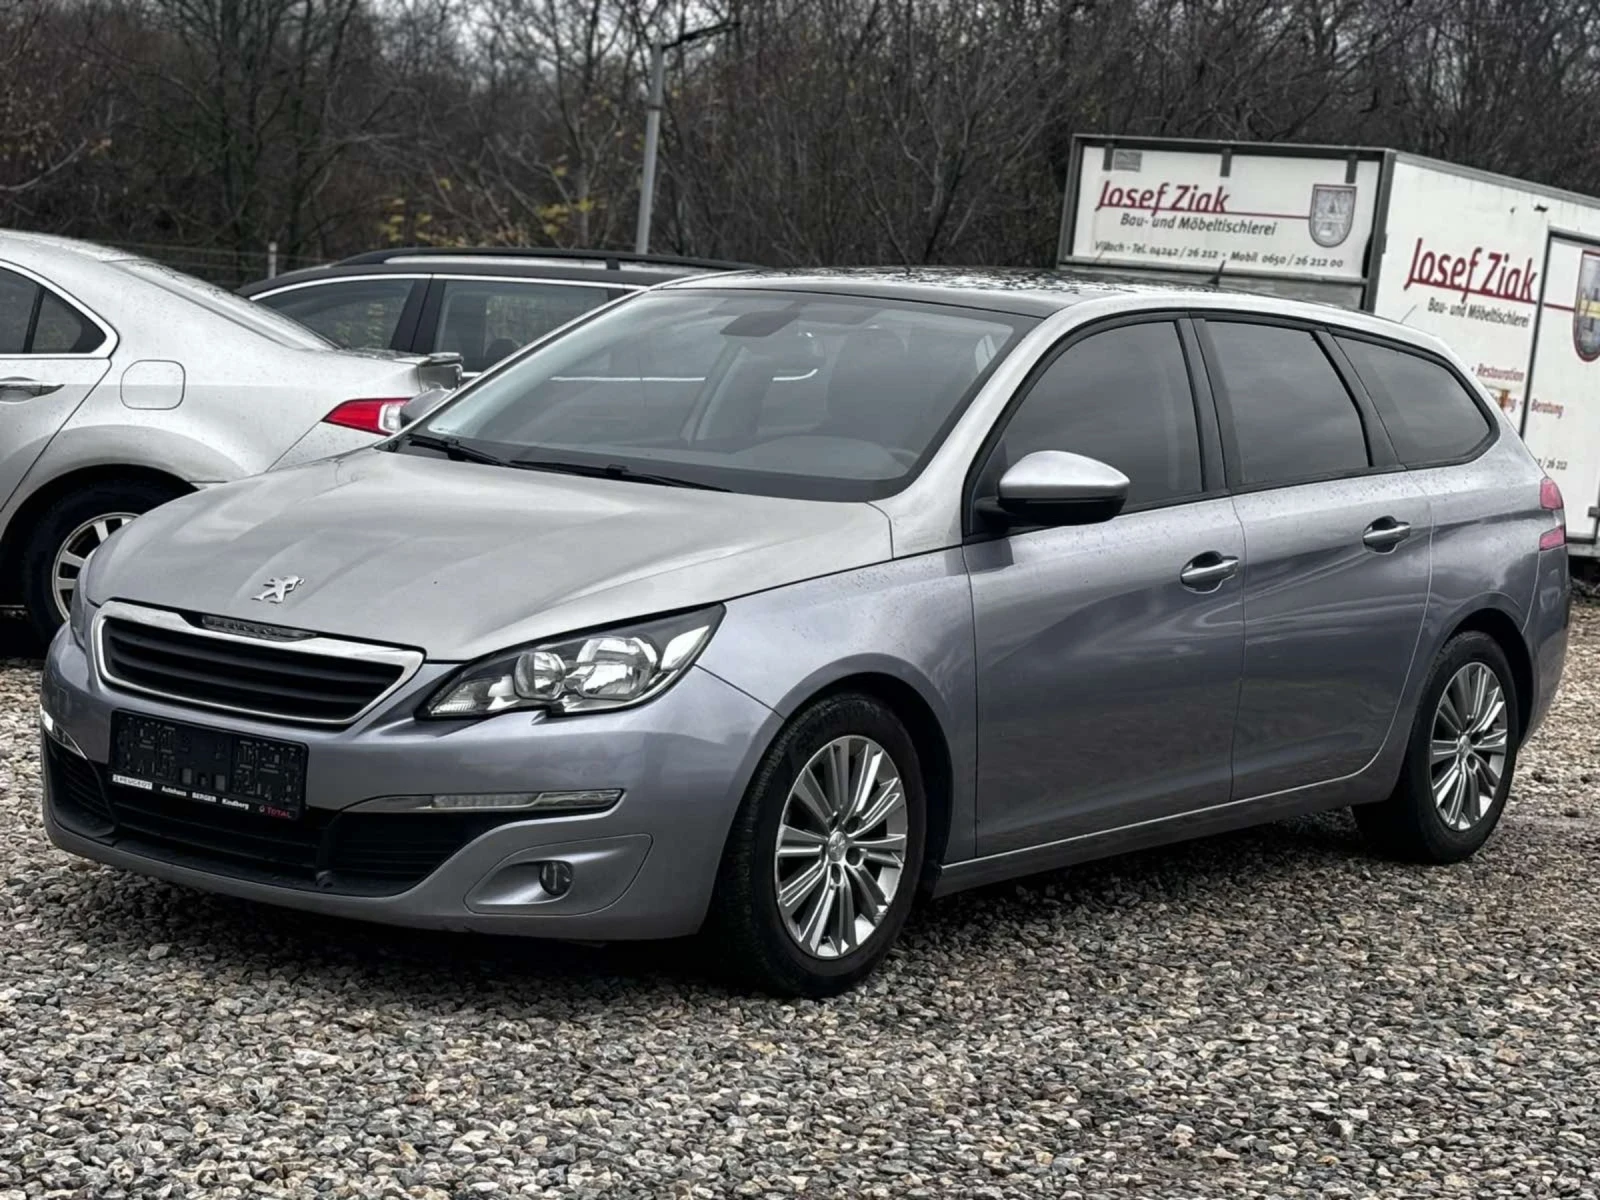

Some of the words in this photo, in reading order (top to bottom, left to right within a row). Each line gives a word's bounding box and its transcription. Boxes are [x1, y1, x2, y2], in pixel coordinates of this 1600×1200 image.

[1094, 180, 1170, 217] Josef
[1169, 184, 1230, 213] Ziak
[1120, 212, 1149, 227] Bau-
[1152, 216, 1176, 229] und
[1177, 217, 1278, 236] Möbeltischlerei
[1403, 237, 1483, 303] Josef
[1480, 251, 1538, 302] Ziak
[1427, 297, 1449, 313] Bau-
[1449, 303, 1467, 318] und
[1467, 306, 1531, 328] Möbeltischlerei
